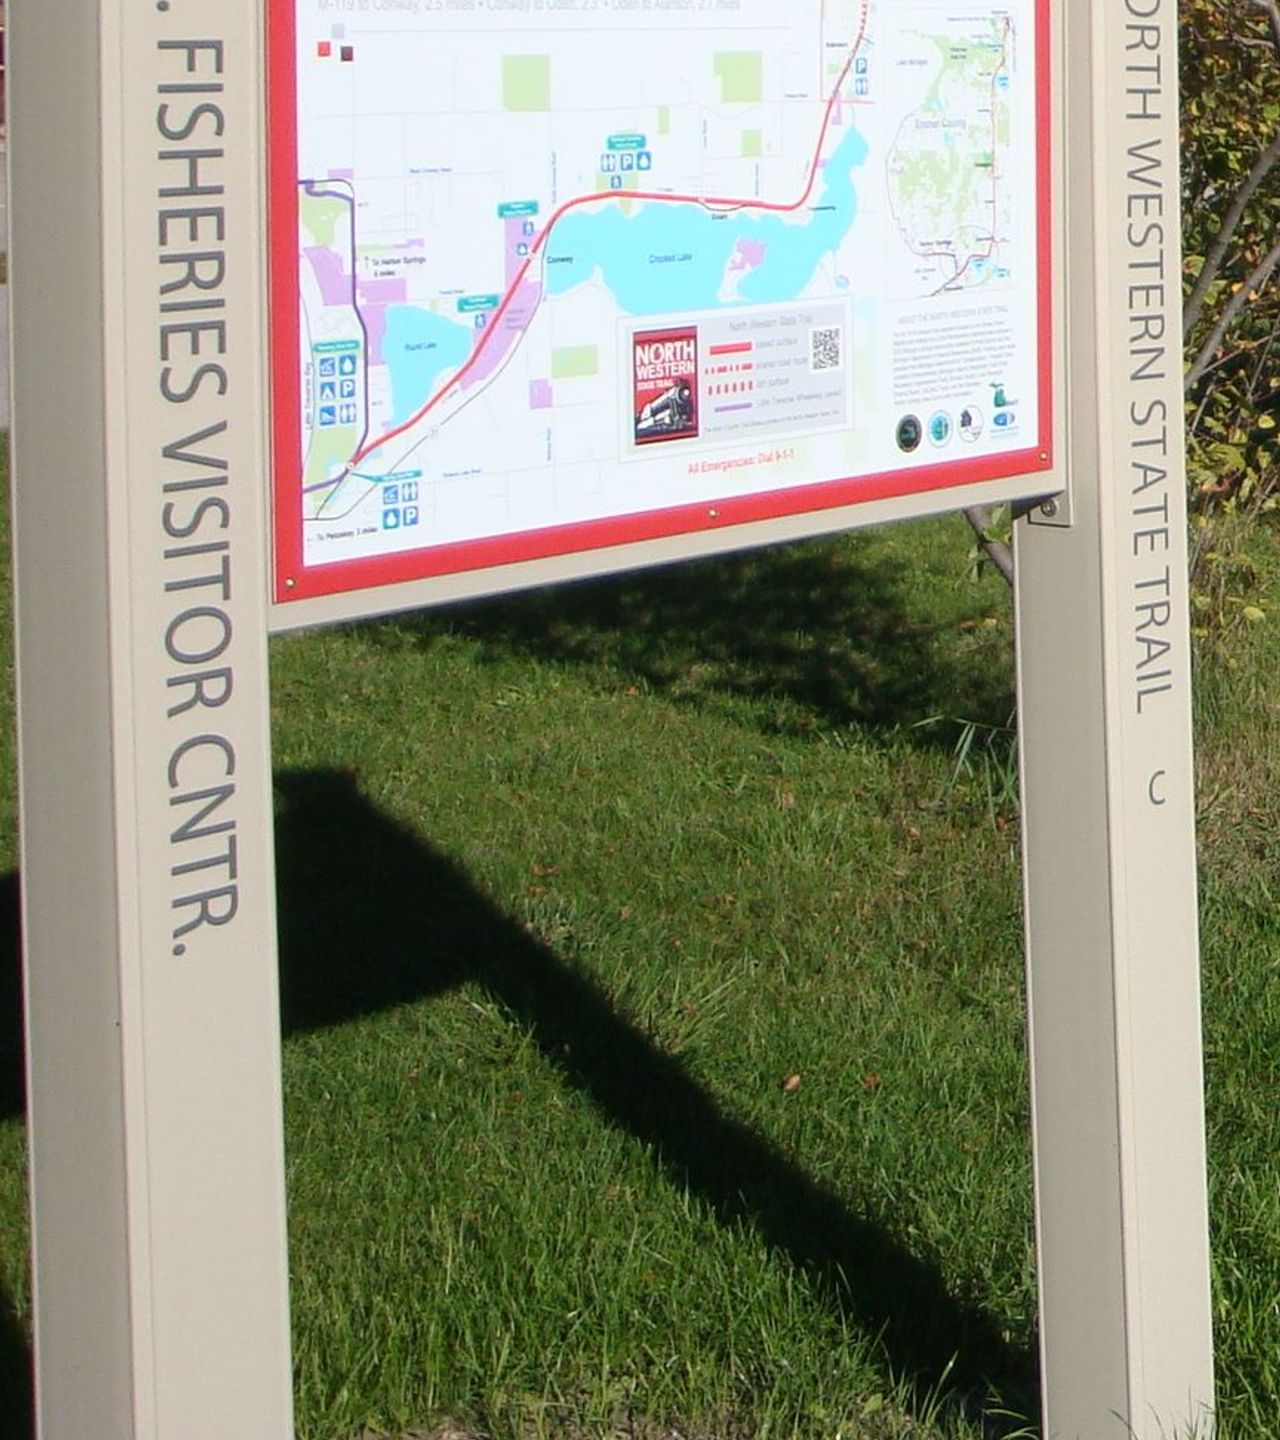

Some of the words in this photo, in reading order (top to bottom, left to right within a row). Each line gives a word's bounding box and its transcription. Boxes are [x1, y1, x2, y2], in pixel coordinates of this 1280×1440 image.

[157, 39, 228, 403] FISHERIES
[1127, 139, 1166, 381] WESTERN
[636, 340, 695, 366] NORTH
[637, 361, 695, 380] WESTERN
[162, 420, 233, 719] VISITOR
[1131, 401, 1169, 557] STATE
[1134, 566, 1173, 715] TRAIL
[168, 734, 239, 957] CNTR.
